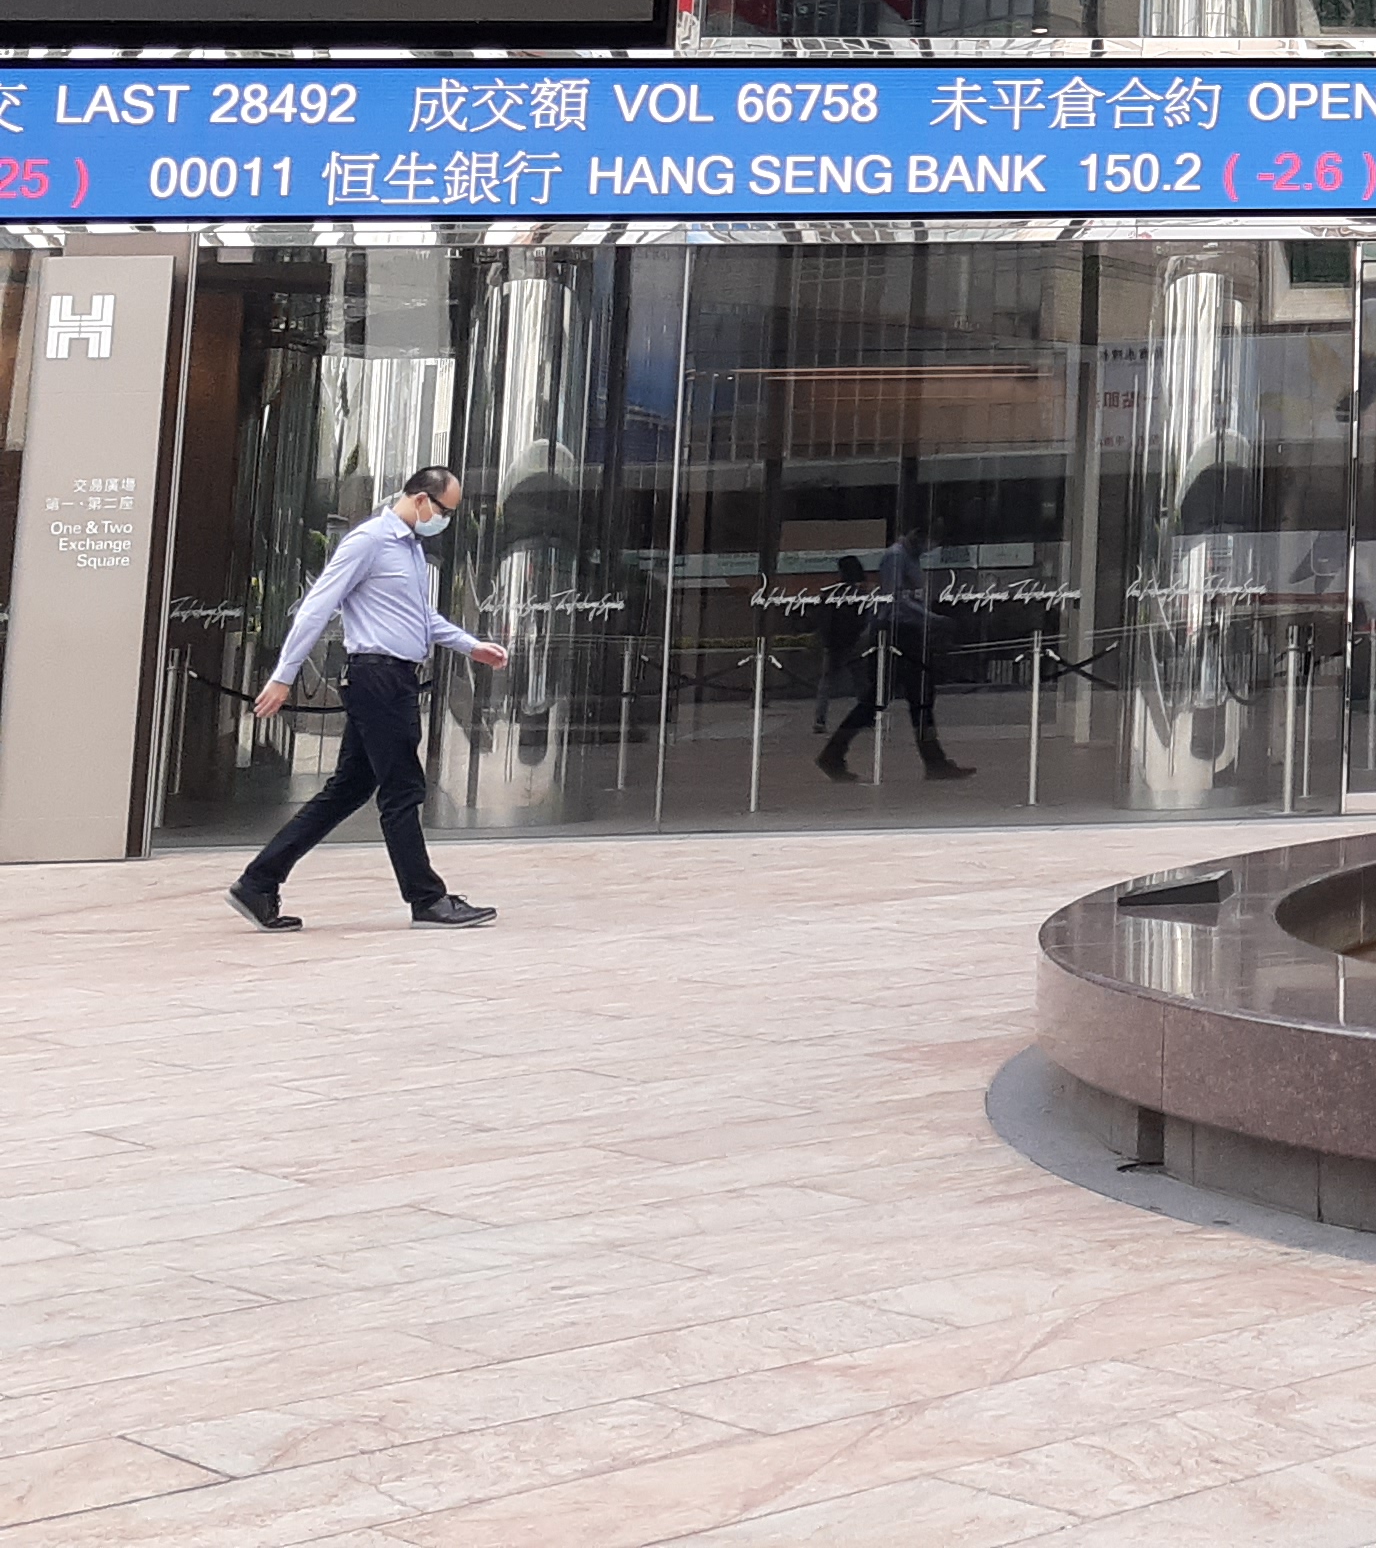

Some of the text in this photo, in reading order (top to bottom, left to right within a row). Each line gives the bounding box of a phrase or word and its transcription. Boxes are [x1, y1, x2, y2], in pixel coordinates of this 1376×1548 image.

[56, 84, 191, 124] LAST
[209, 83, 357, 124] 28492
[408, 77, 591, 133] 成交額
[613, 83, 714, 123] VOL
[737, 83, 878, 123] 66758
[929, 76, 1222, 131] 未平倉合約
[150, 156, 291, 198] 00011
[589, 155, 734, 195] HANG
[749, 154, 892, 195] SENG
[908, 154, 1047, 193] BANK
[1080, 152, 1201, 192] 150.2
[50, 520, 133, 535] One & Two
[58, 537, 132, 553] Exchange
[76, 553, 130, 569] Square
